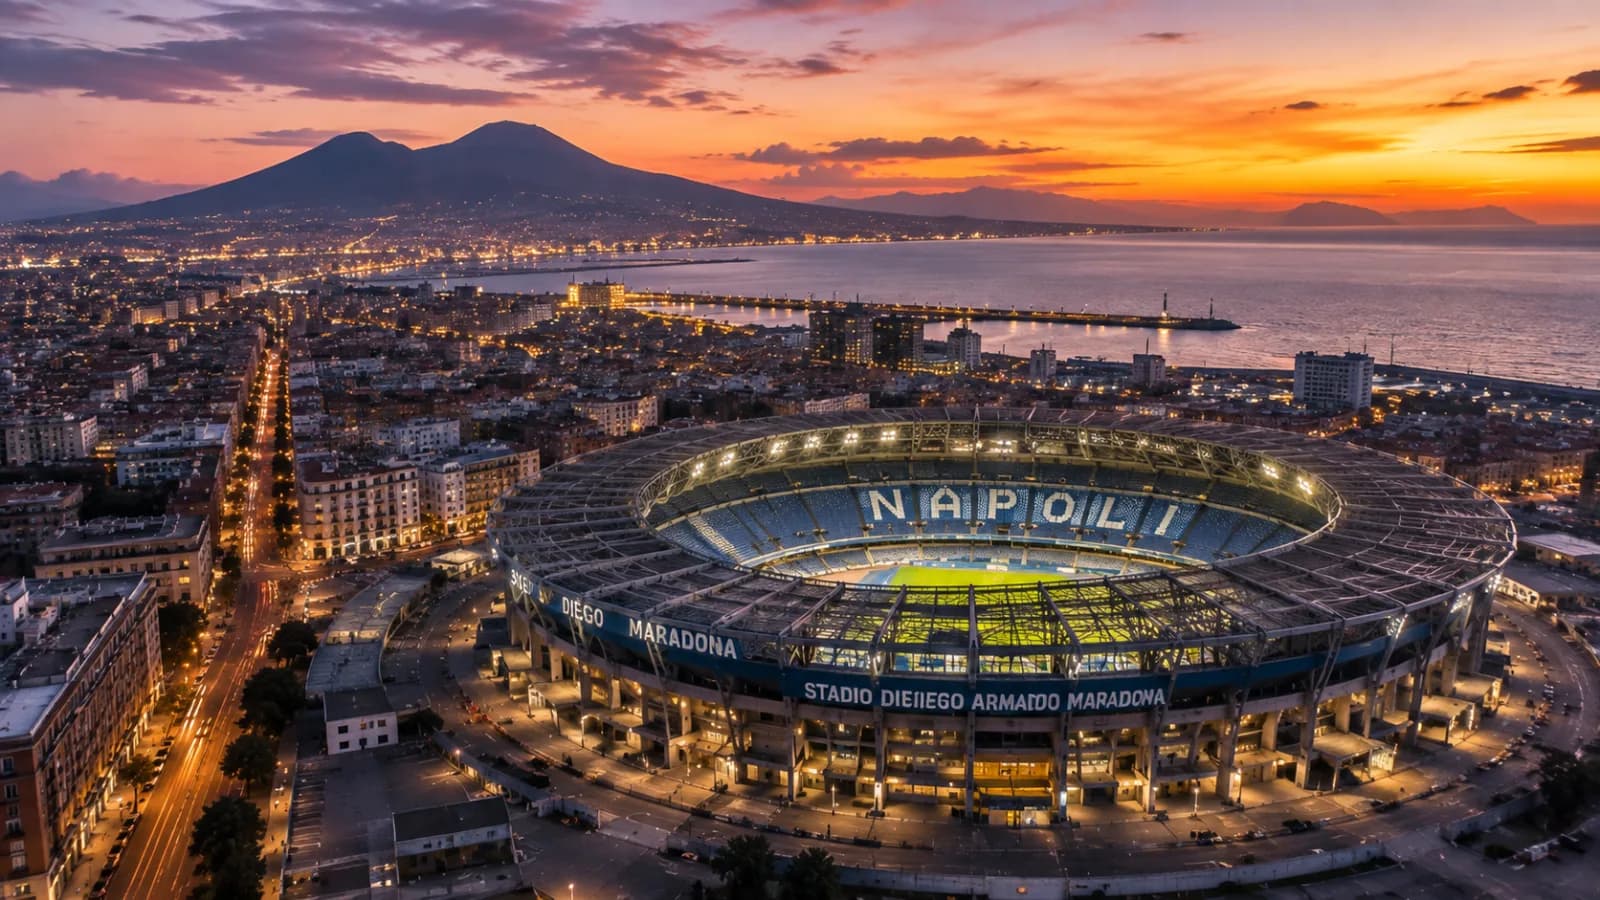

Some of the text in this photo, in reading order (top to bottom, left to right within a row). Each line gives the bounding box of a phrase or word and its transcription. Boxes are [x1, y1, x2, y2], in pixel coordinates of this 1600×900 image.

[868, 487, 1178, 535] NAPOLI
[561, 596, 738, 660] DIEGO MARADONA
[804, 682, 873, 705] STADIO
[1067, 688, 1166, 711] MARADONA
